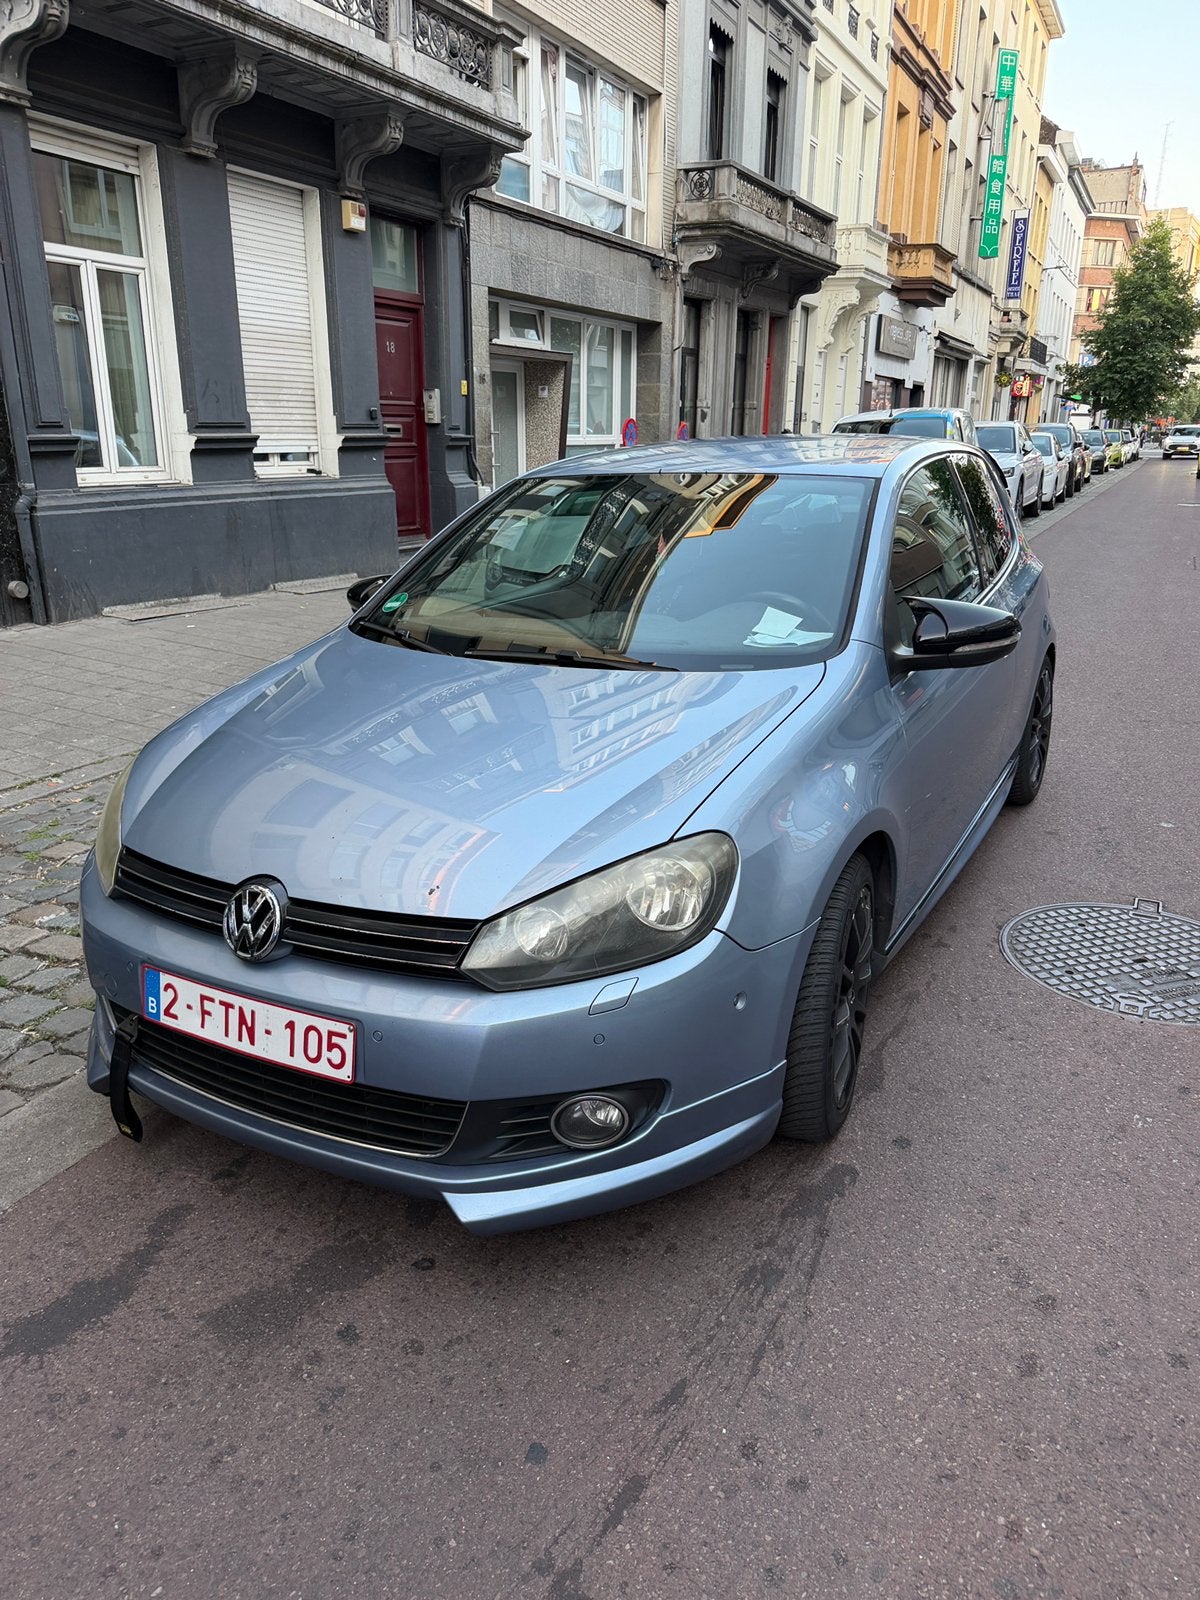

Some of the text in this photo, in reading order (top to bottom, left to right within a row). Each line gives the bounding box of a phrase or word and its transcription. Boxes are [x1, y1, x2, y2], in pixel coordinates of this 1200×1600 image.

[984, 53, 1016, 235] 中華 館食用品
[1010, 219, 1025, 285] SEREE
[386, 341, 395, 353] 18
[224, 886, 279, 959] VW
[148, 996, 157, 1014] B
[163, 982, 348, 1070] 2-FTN-105
